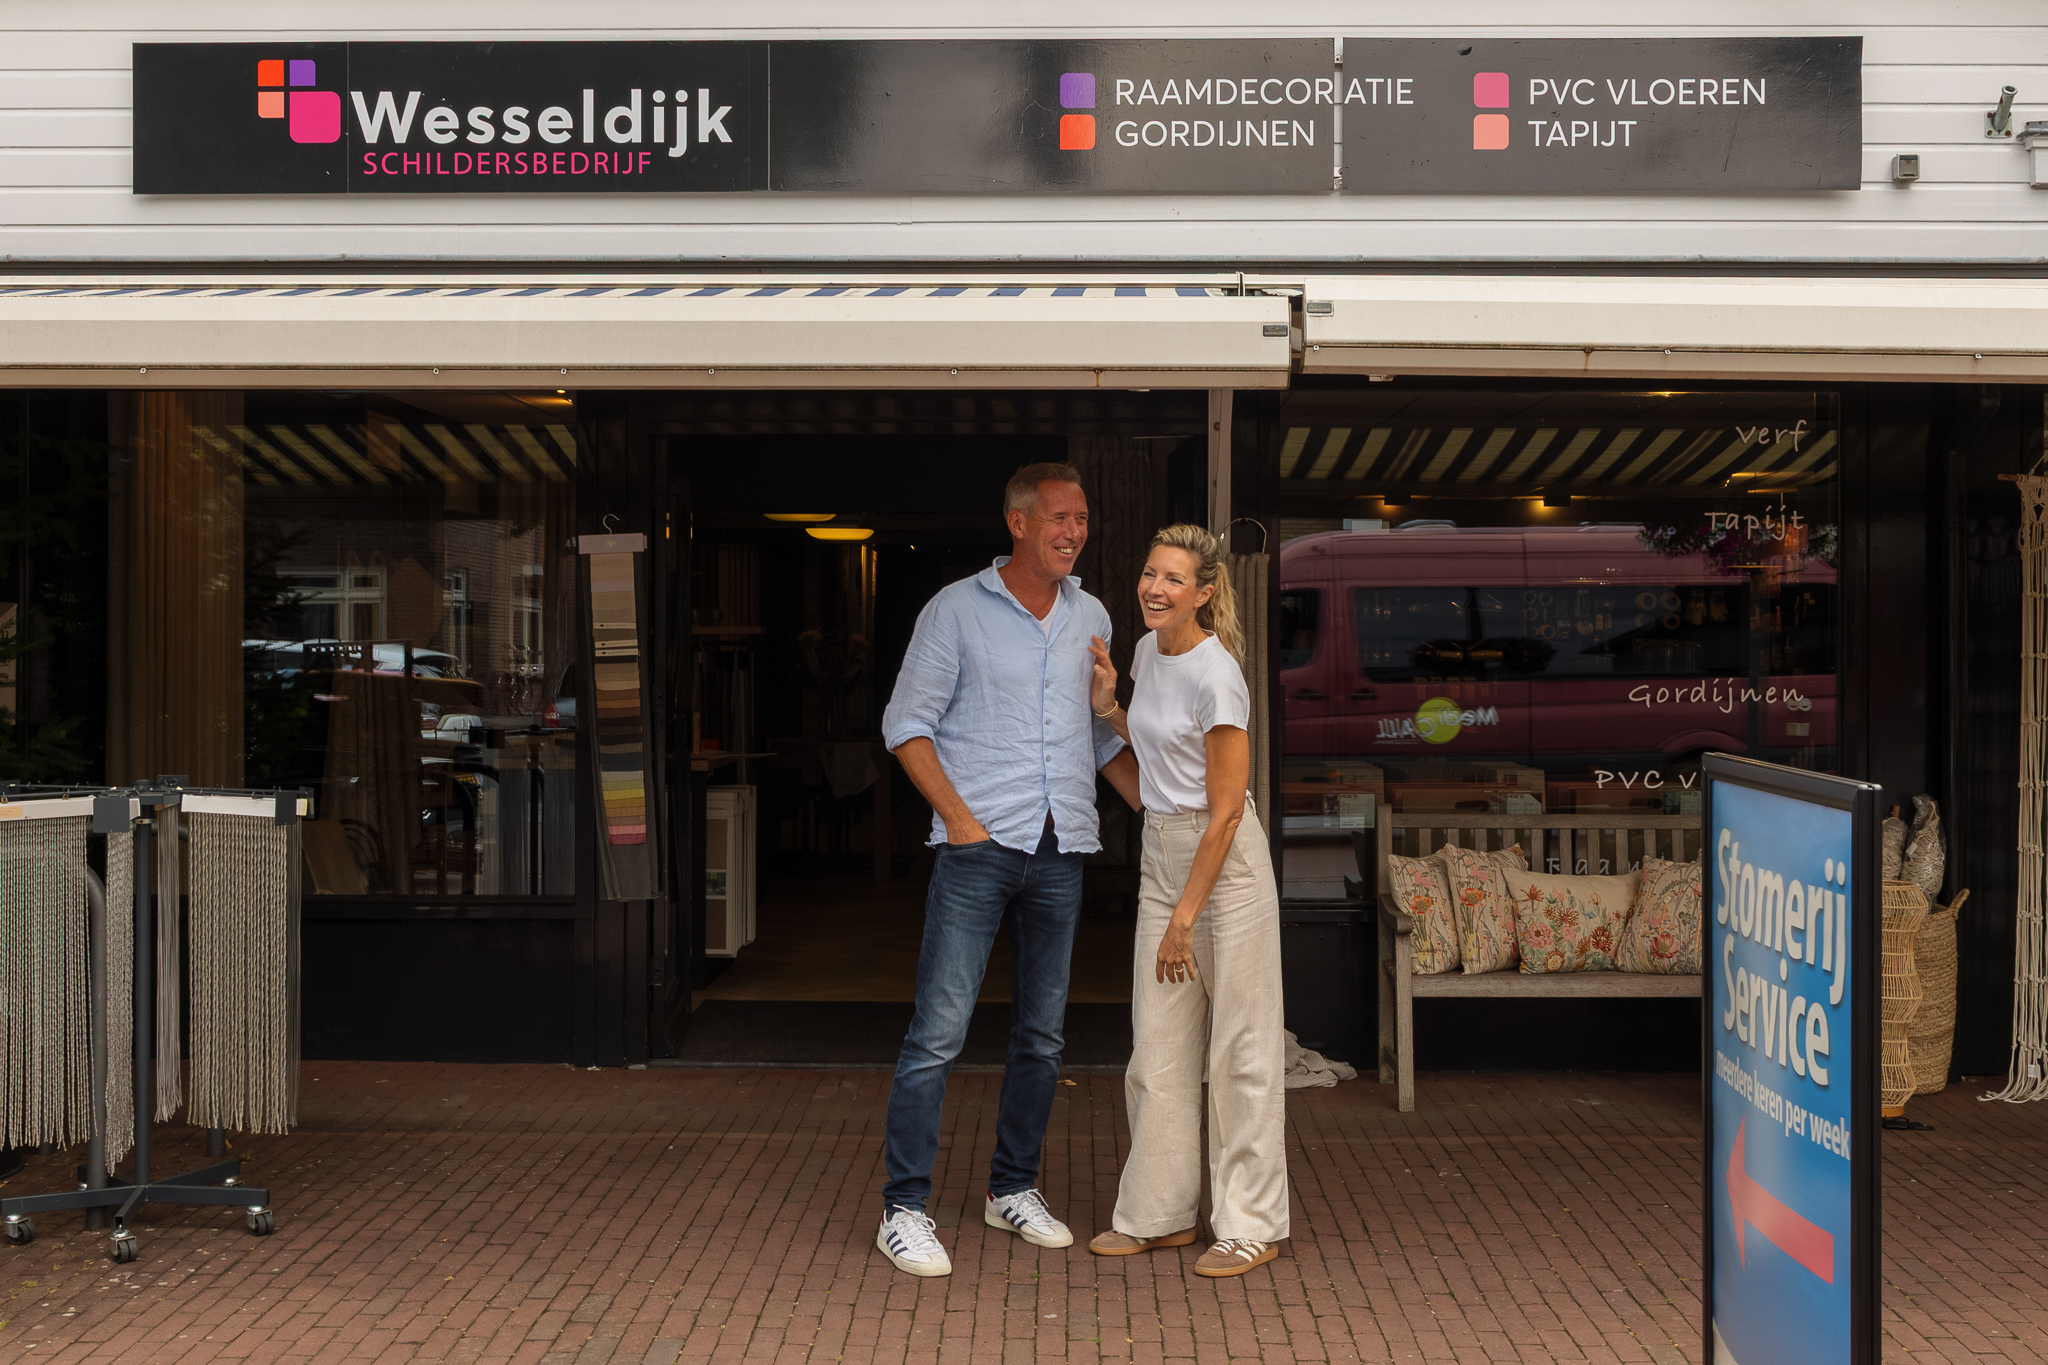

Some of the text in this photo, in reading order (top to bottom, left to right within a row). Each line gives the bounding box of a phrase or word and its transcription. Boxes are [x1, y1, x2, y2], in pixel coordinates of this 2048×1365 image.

[1115, 78, 1414, 106] RAAMDECORATIE
[1529, 78, 1767, 106] PVC VLOEREN
[350, 88, 733, 157] Wesseldijk
[1115, 119, 1315, 147] GORDIJNEN
[1527, 120, 1638, 147] TAPIJT
[363, 151, 651, 176] SCHILDERSBEDRIJF
[1704, 505, 1804, 541] Tapijt
[1628, 678, 1804, 713] Gordijnen
[1594, 769, 1664, 789] PVC
[1717, 828, 1846, 1005] Stomerij
[1723, 933, 1830, 1086] Service
[1716, 1050, 1850, 1161] meerdere keren per week
